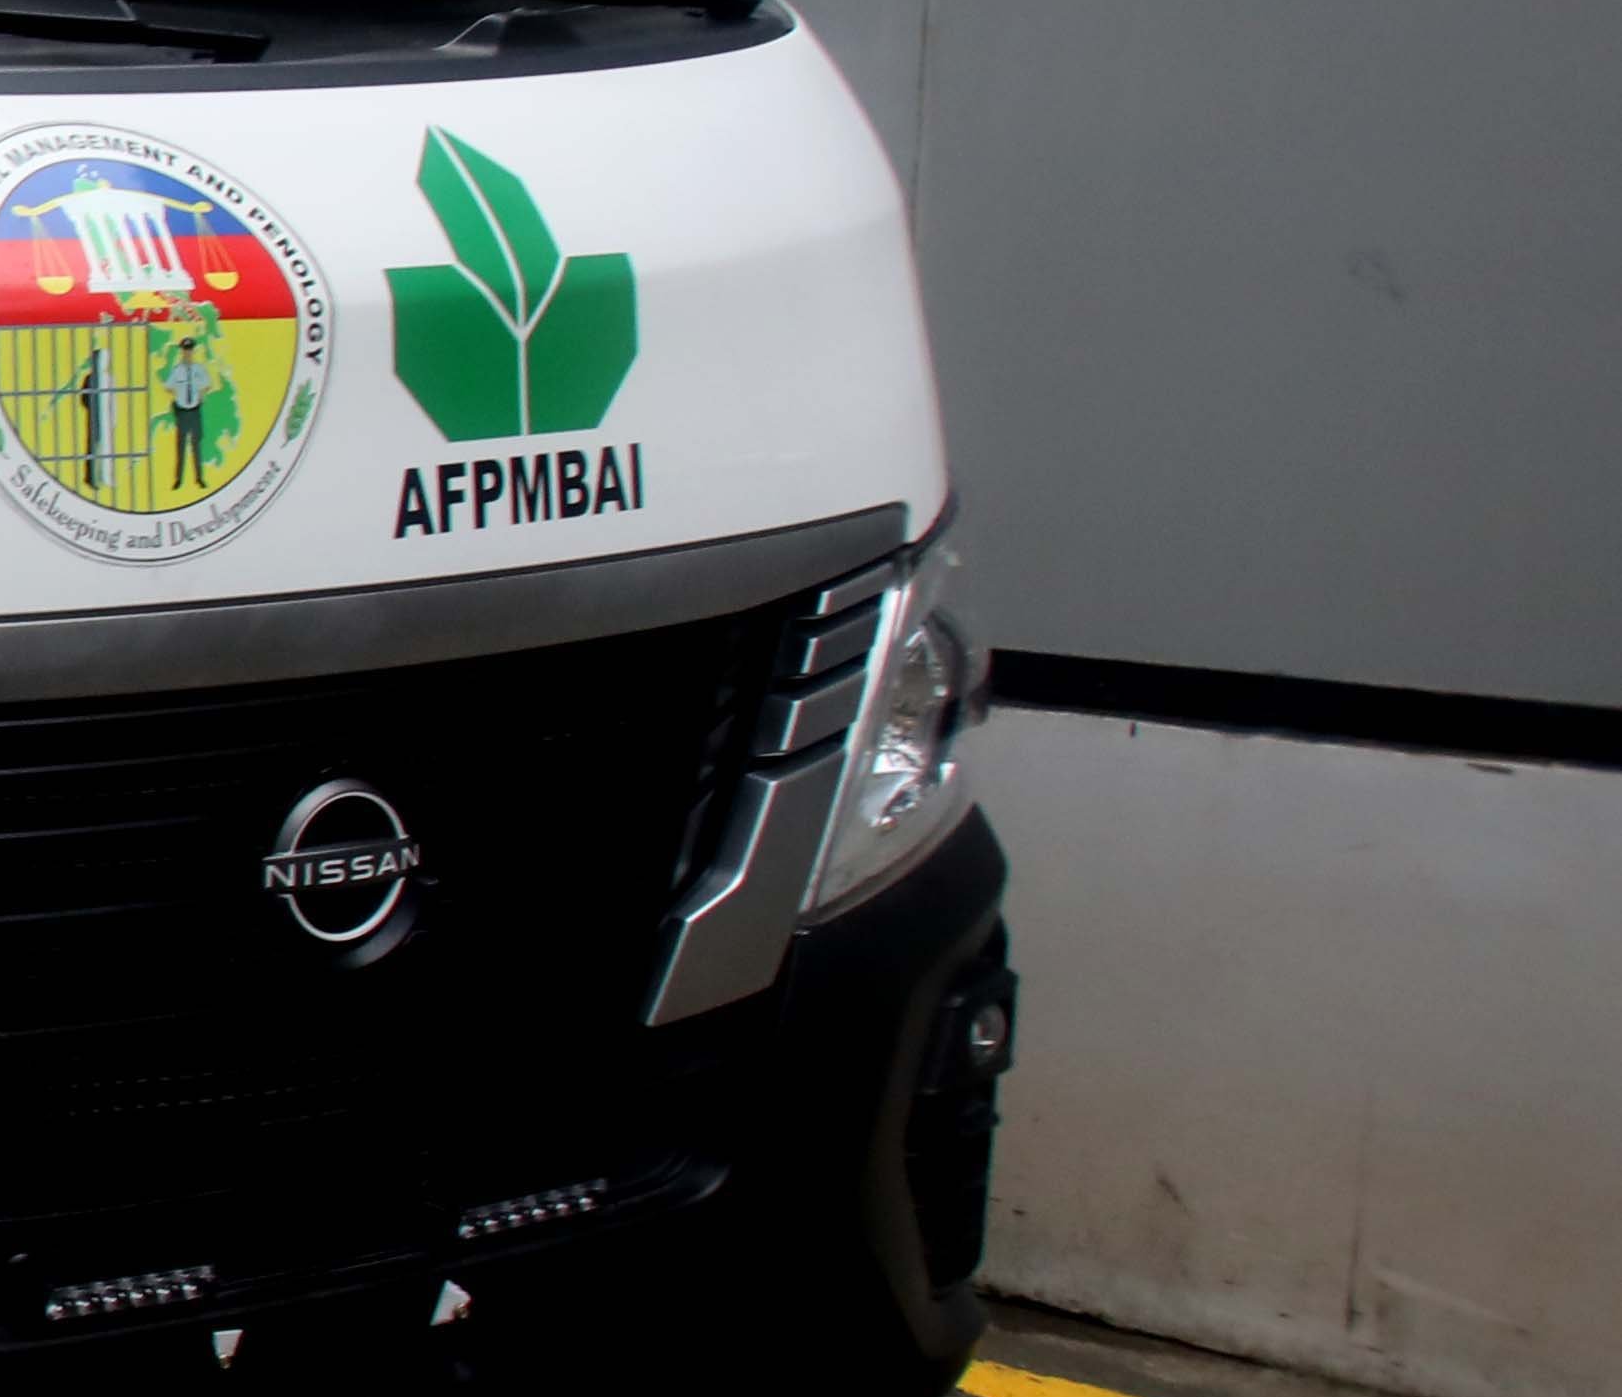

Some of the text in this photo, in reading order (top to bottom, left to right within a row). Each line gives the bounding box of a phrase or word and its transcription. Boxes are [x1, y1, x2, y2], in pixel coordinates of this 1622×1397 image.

[4, 133, 178, 167] MANAGEMENT
[186, 164, 244, 206] AND
[247, 207, 325, 365] PENOLOGY
[9, 459, 282, 552] Safekeeping and Development
[394, 442, 645, 539] AFPMBAI
[263, 843, 421, 889] NISSAN
